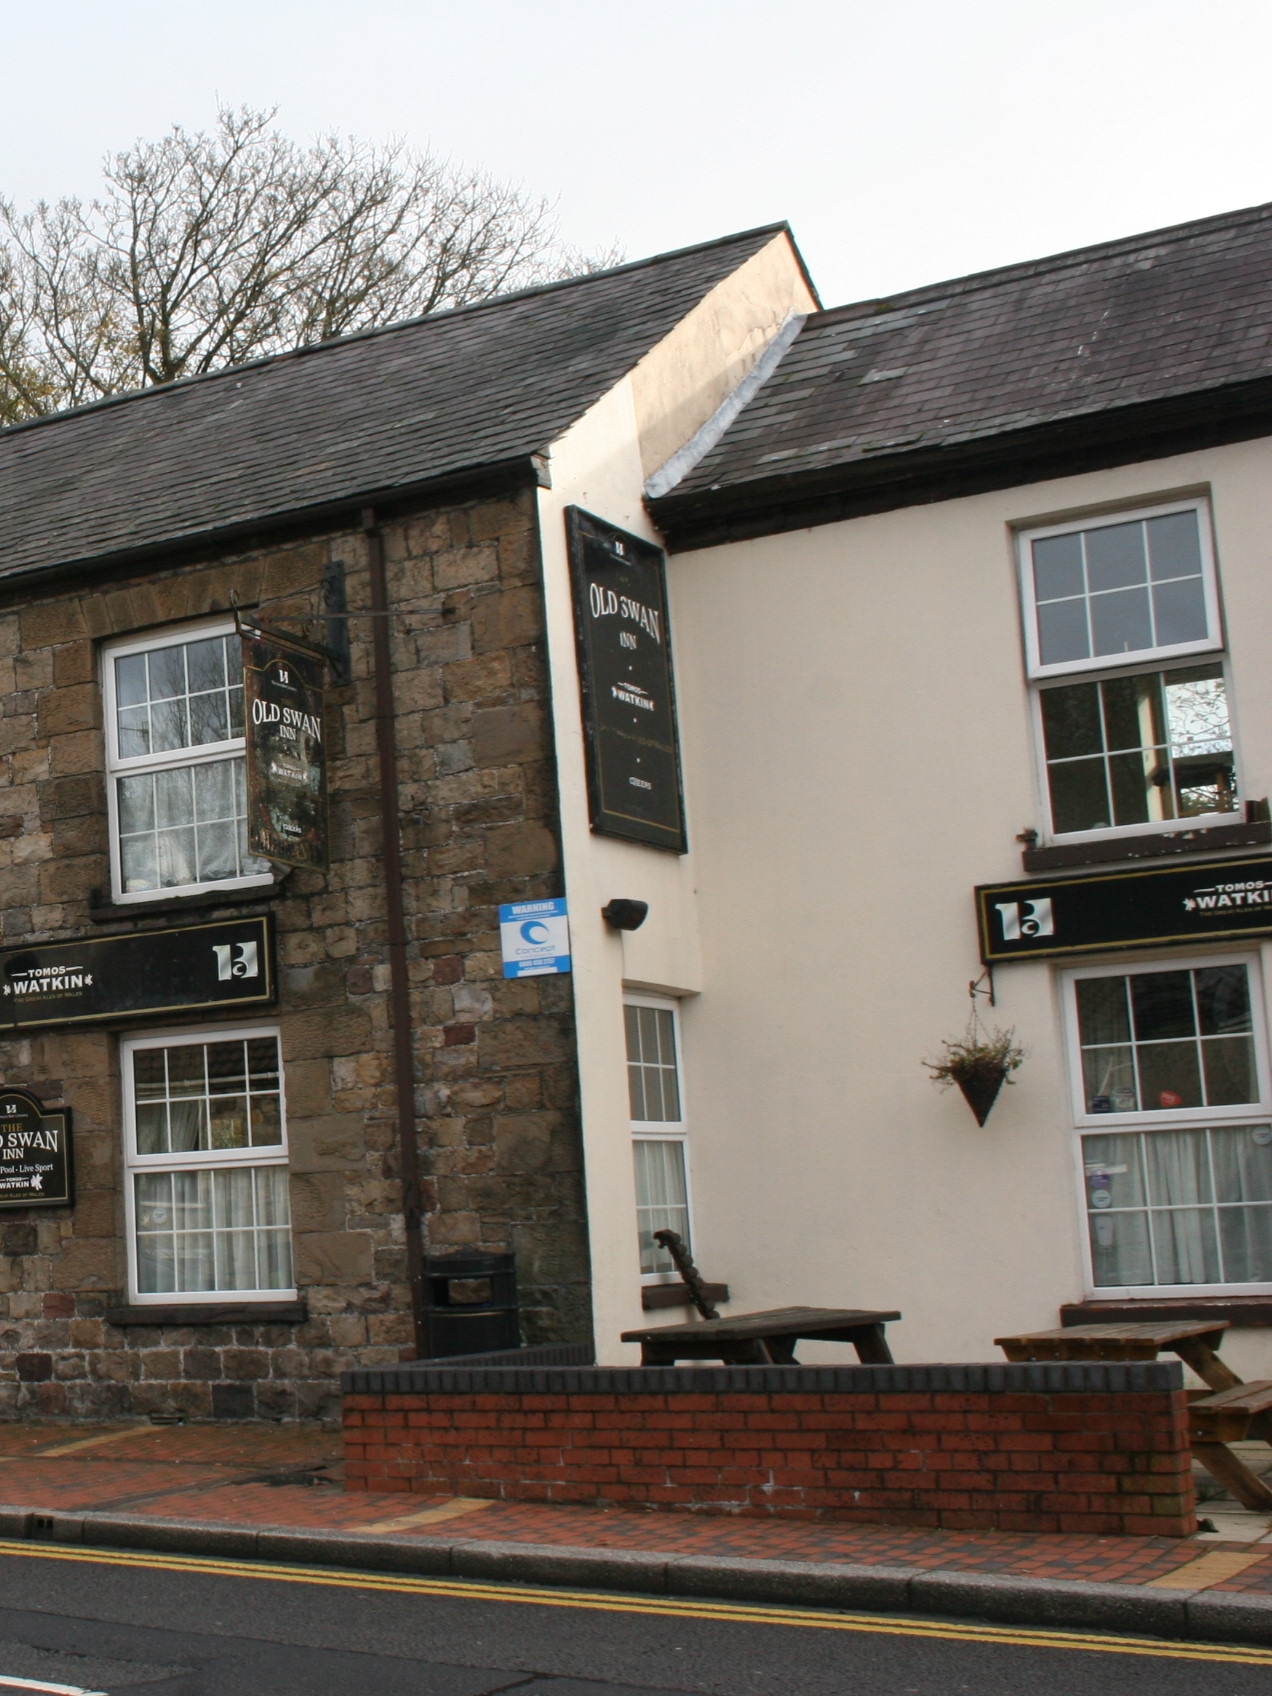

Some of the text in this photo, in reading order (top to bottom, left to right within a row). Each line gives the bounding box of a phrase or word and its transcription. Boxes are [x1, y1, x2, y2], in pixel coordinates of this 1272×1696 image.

[590, 583, 660, 644] OLD SWAN
[619, 631, 636, 650] INN
[617, 692, 650, 711] WATKIN
[252, 699, 320, 742] OLD SWAN
[279, 725, 296, 741] INN
[1215, 880, 1265, 893] TOMOS
[1196, 889, 1272, 909] WATKI
[512, 902, 555, 914] WARNING
[28, 966, 66, 977] TOMOS
[13, 974, 83, 995] WATKIN
[1, 1123, 22, 1132] THE
[7, 1129, 58, 1153] SWAN
[2, 1148, 24, 1160] INN
[0, 1165, 15, 1174] Pool
[19, 1164, 34, 1173] Live
[35, 1163, 53, 1172] Sport
[0, 1181, 29, 1189] WATKIN
